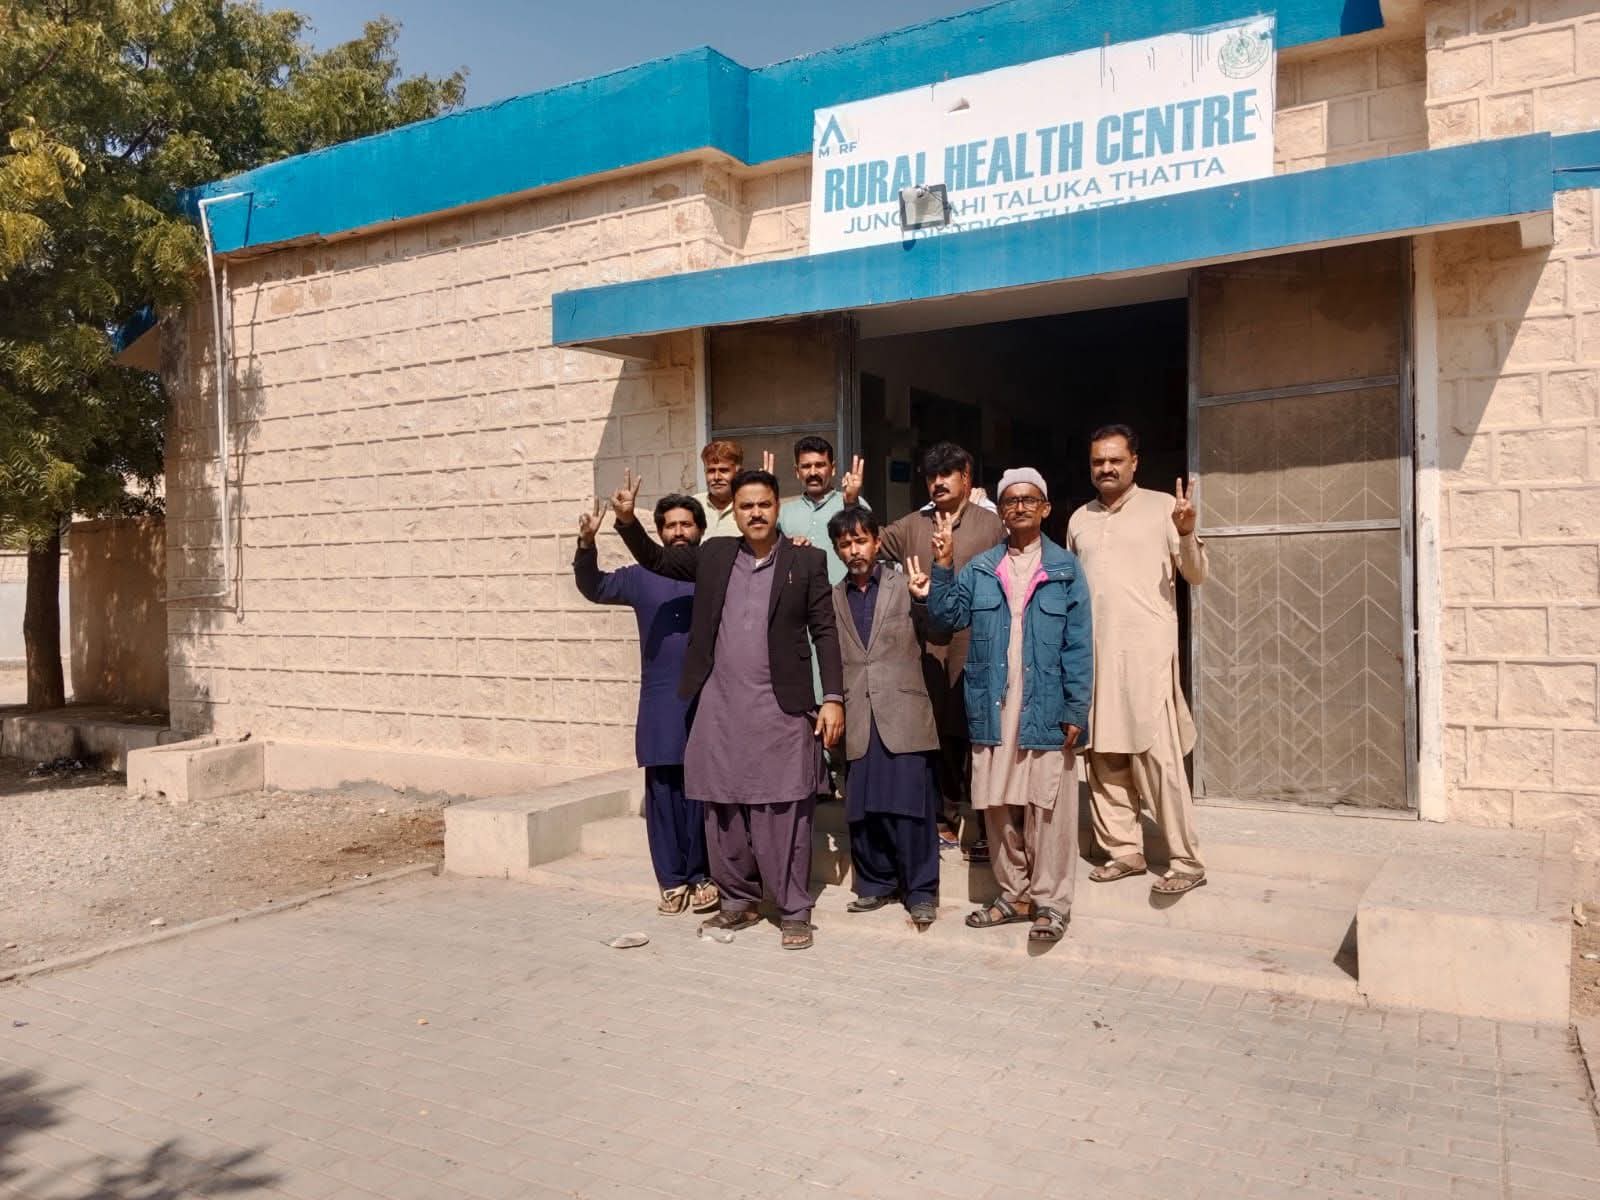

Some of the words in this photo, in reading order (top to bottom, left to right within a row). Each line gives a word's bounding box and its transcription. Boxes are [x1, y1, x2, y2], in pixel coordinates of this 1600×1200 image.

[824, 152, 927, 213] RURAL
[944, 120, 1084, 193] HEALTH
[1095, 88, 1257, 166] CENTRE
[844, 195, 986, 234] JUNAHI
[993, 177, 1102, 210] TALUKA
[1109, 156, 1226, 191] THATTA
